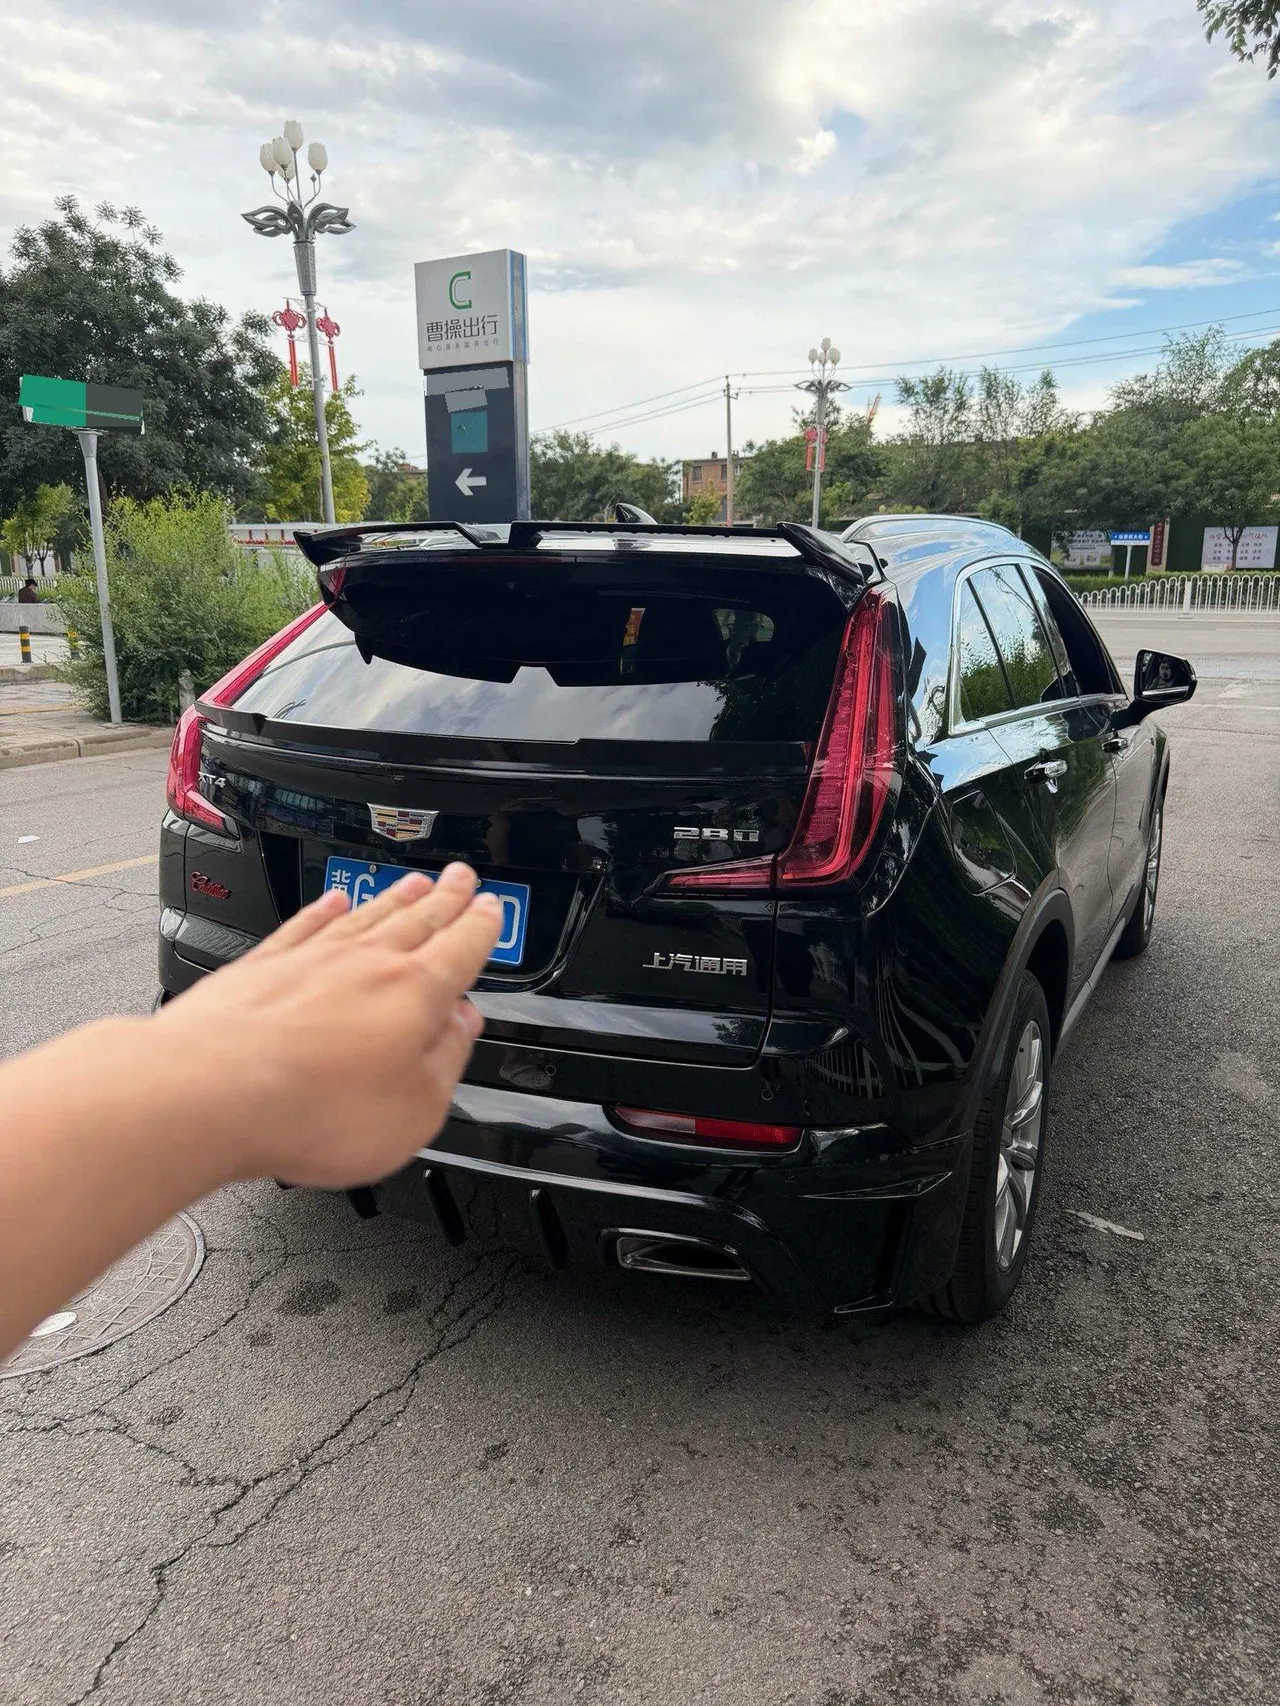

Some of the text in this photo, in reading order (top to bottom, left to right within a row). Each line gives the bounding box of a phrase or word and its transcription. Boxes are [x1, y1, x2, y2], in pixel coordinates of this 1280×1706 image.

[426, 314, 499, 342] 曹操出行
[197, 771, 226, 789] XT4
[673, 826, 760, 842] 28T
[642, 952, 748, 977] 上汽通用
